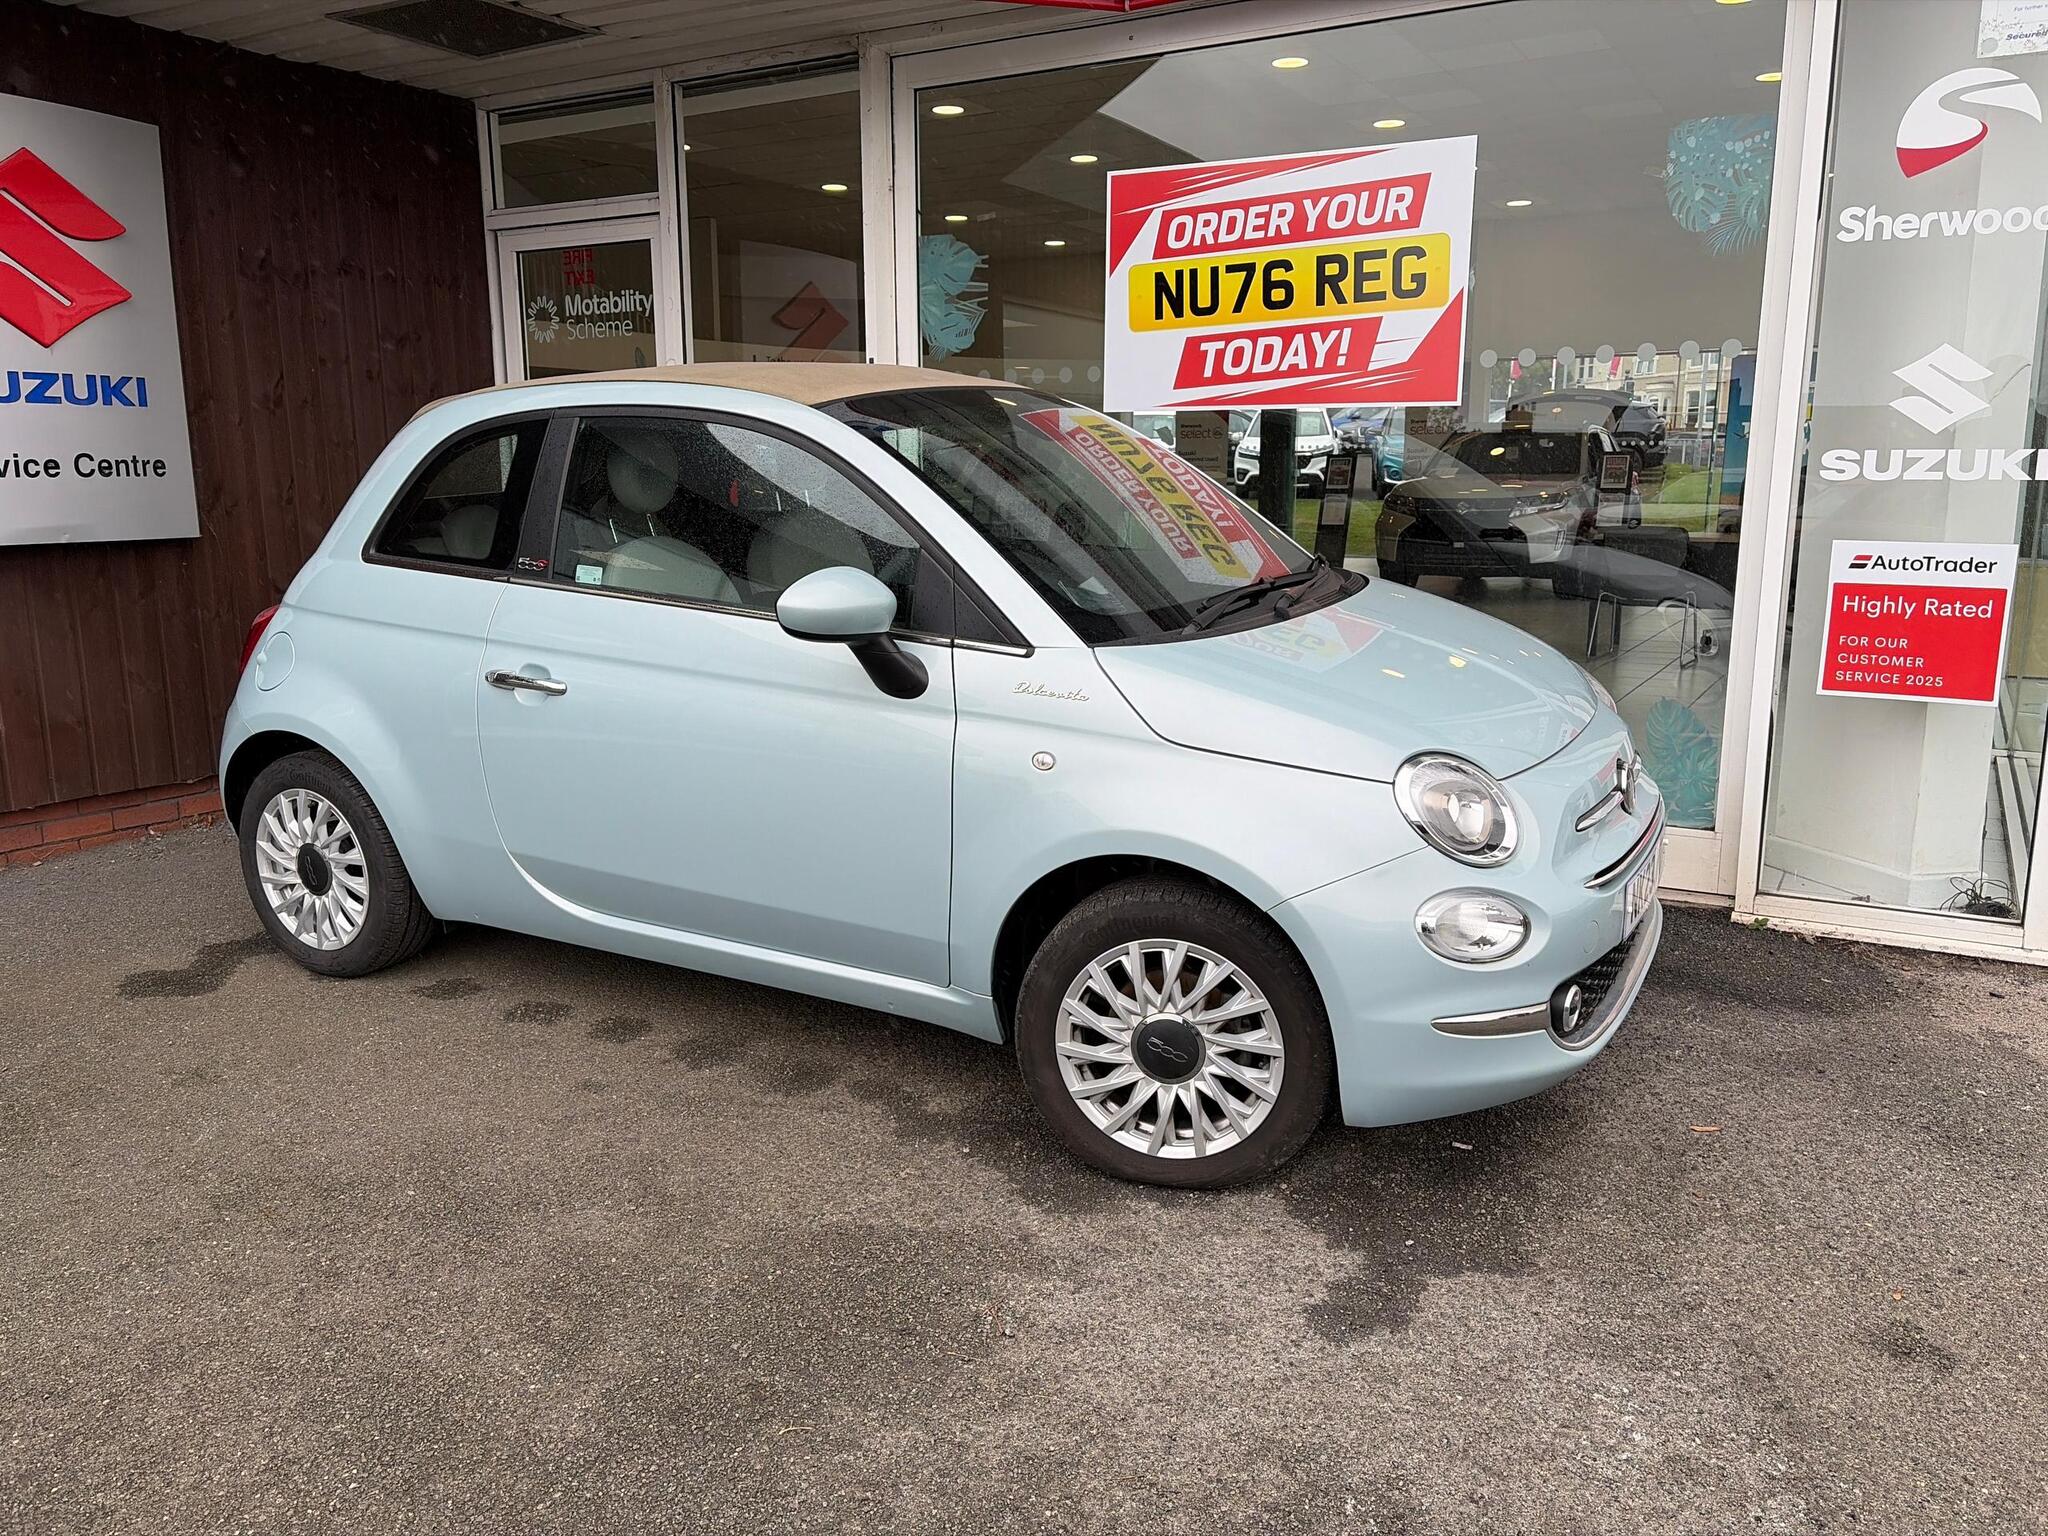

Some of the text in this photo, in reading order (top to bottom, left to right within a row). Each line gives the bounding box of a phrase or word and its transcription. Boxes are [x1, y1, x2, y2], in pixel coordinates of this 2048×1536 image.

[1166, 185, 1415, 250] ORDER YOUR
[1153, 245, 1428, 321] NU76 REG
[564, 288, 653, 317] Motability
[566, 317, 633, 340] Scheme
[1200, 327, 1353, 378] TODAY!
[0, 370, 149, 408] UZUKI
[73, 452, 168, 478] Centre
[1871, 555, 1998, 574] AutoTrader
[1843, 595, 1994, 620] Highly Rated
[1839, 635, 1909, 649] FOR OUR
[1837, 652, 1925, 668] CUSTOMER
[1835, 670, 1944, 688] SERVICE 2025
